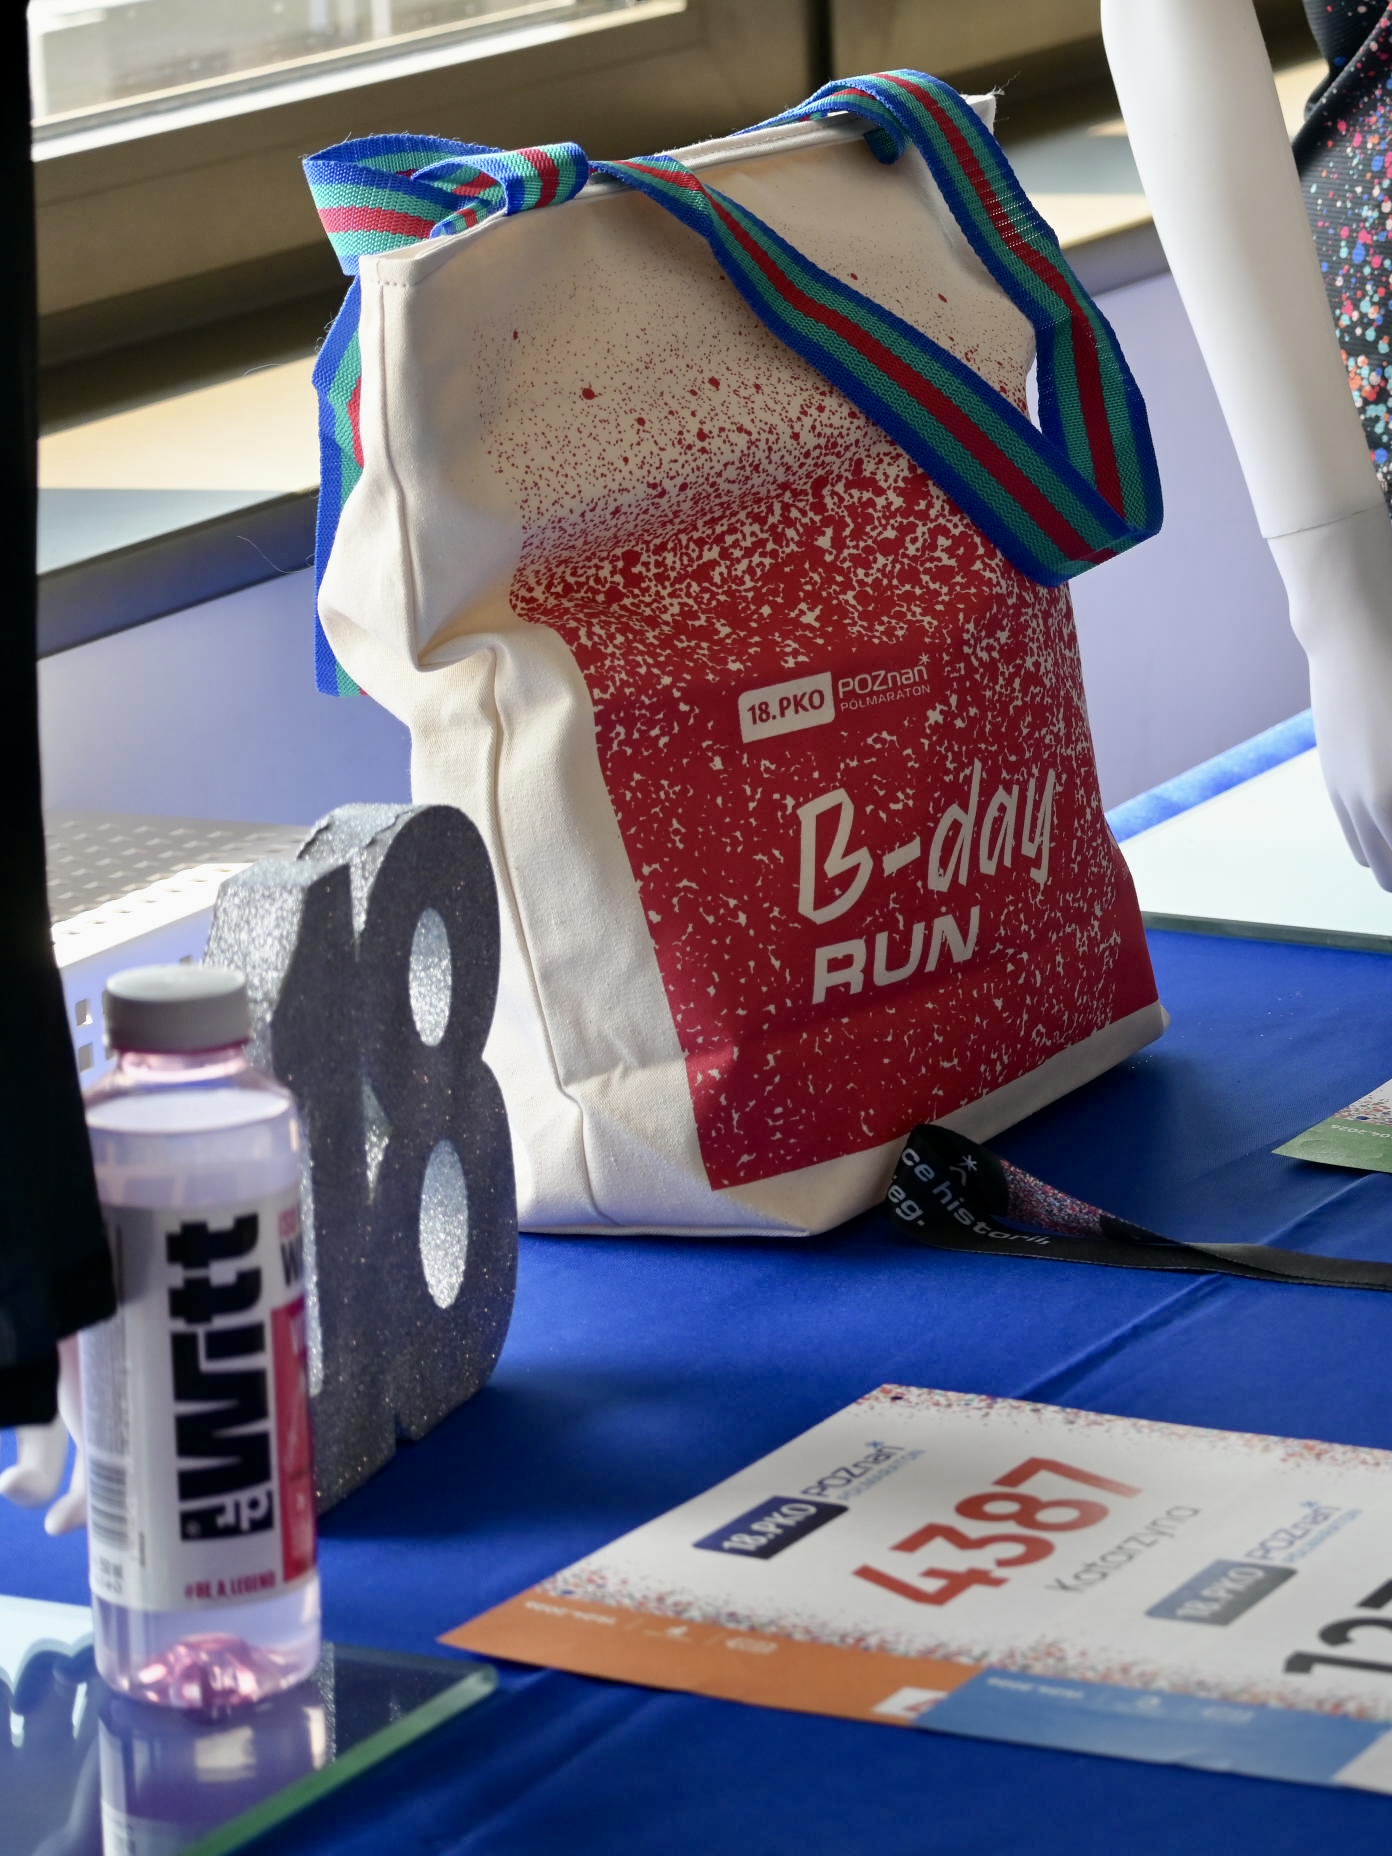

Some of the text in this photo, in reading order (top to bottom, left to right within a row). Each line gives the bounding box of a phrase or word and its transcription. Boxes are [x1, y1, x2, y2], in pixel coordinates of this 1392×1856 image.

[746, 688, 826, 728] 18.PKO
[797, 757, 1057, 925] B-day
[811, 904, 981, 1005] RUN
[166, 1211, 272, 1502] Witt
[721, 1501, 820, 1554] 18.PKO
[851, 1456, 1143, 1607] 4387
[1043, 1504, 1202, 1595] Katarzyna
[1175, 1566, 1267, 1620] 18.PKO
